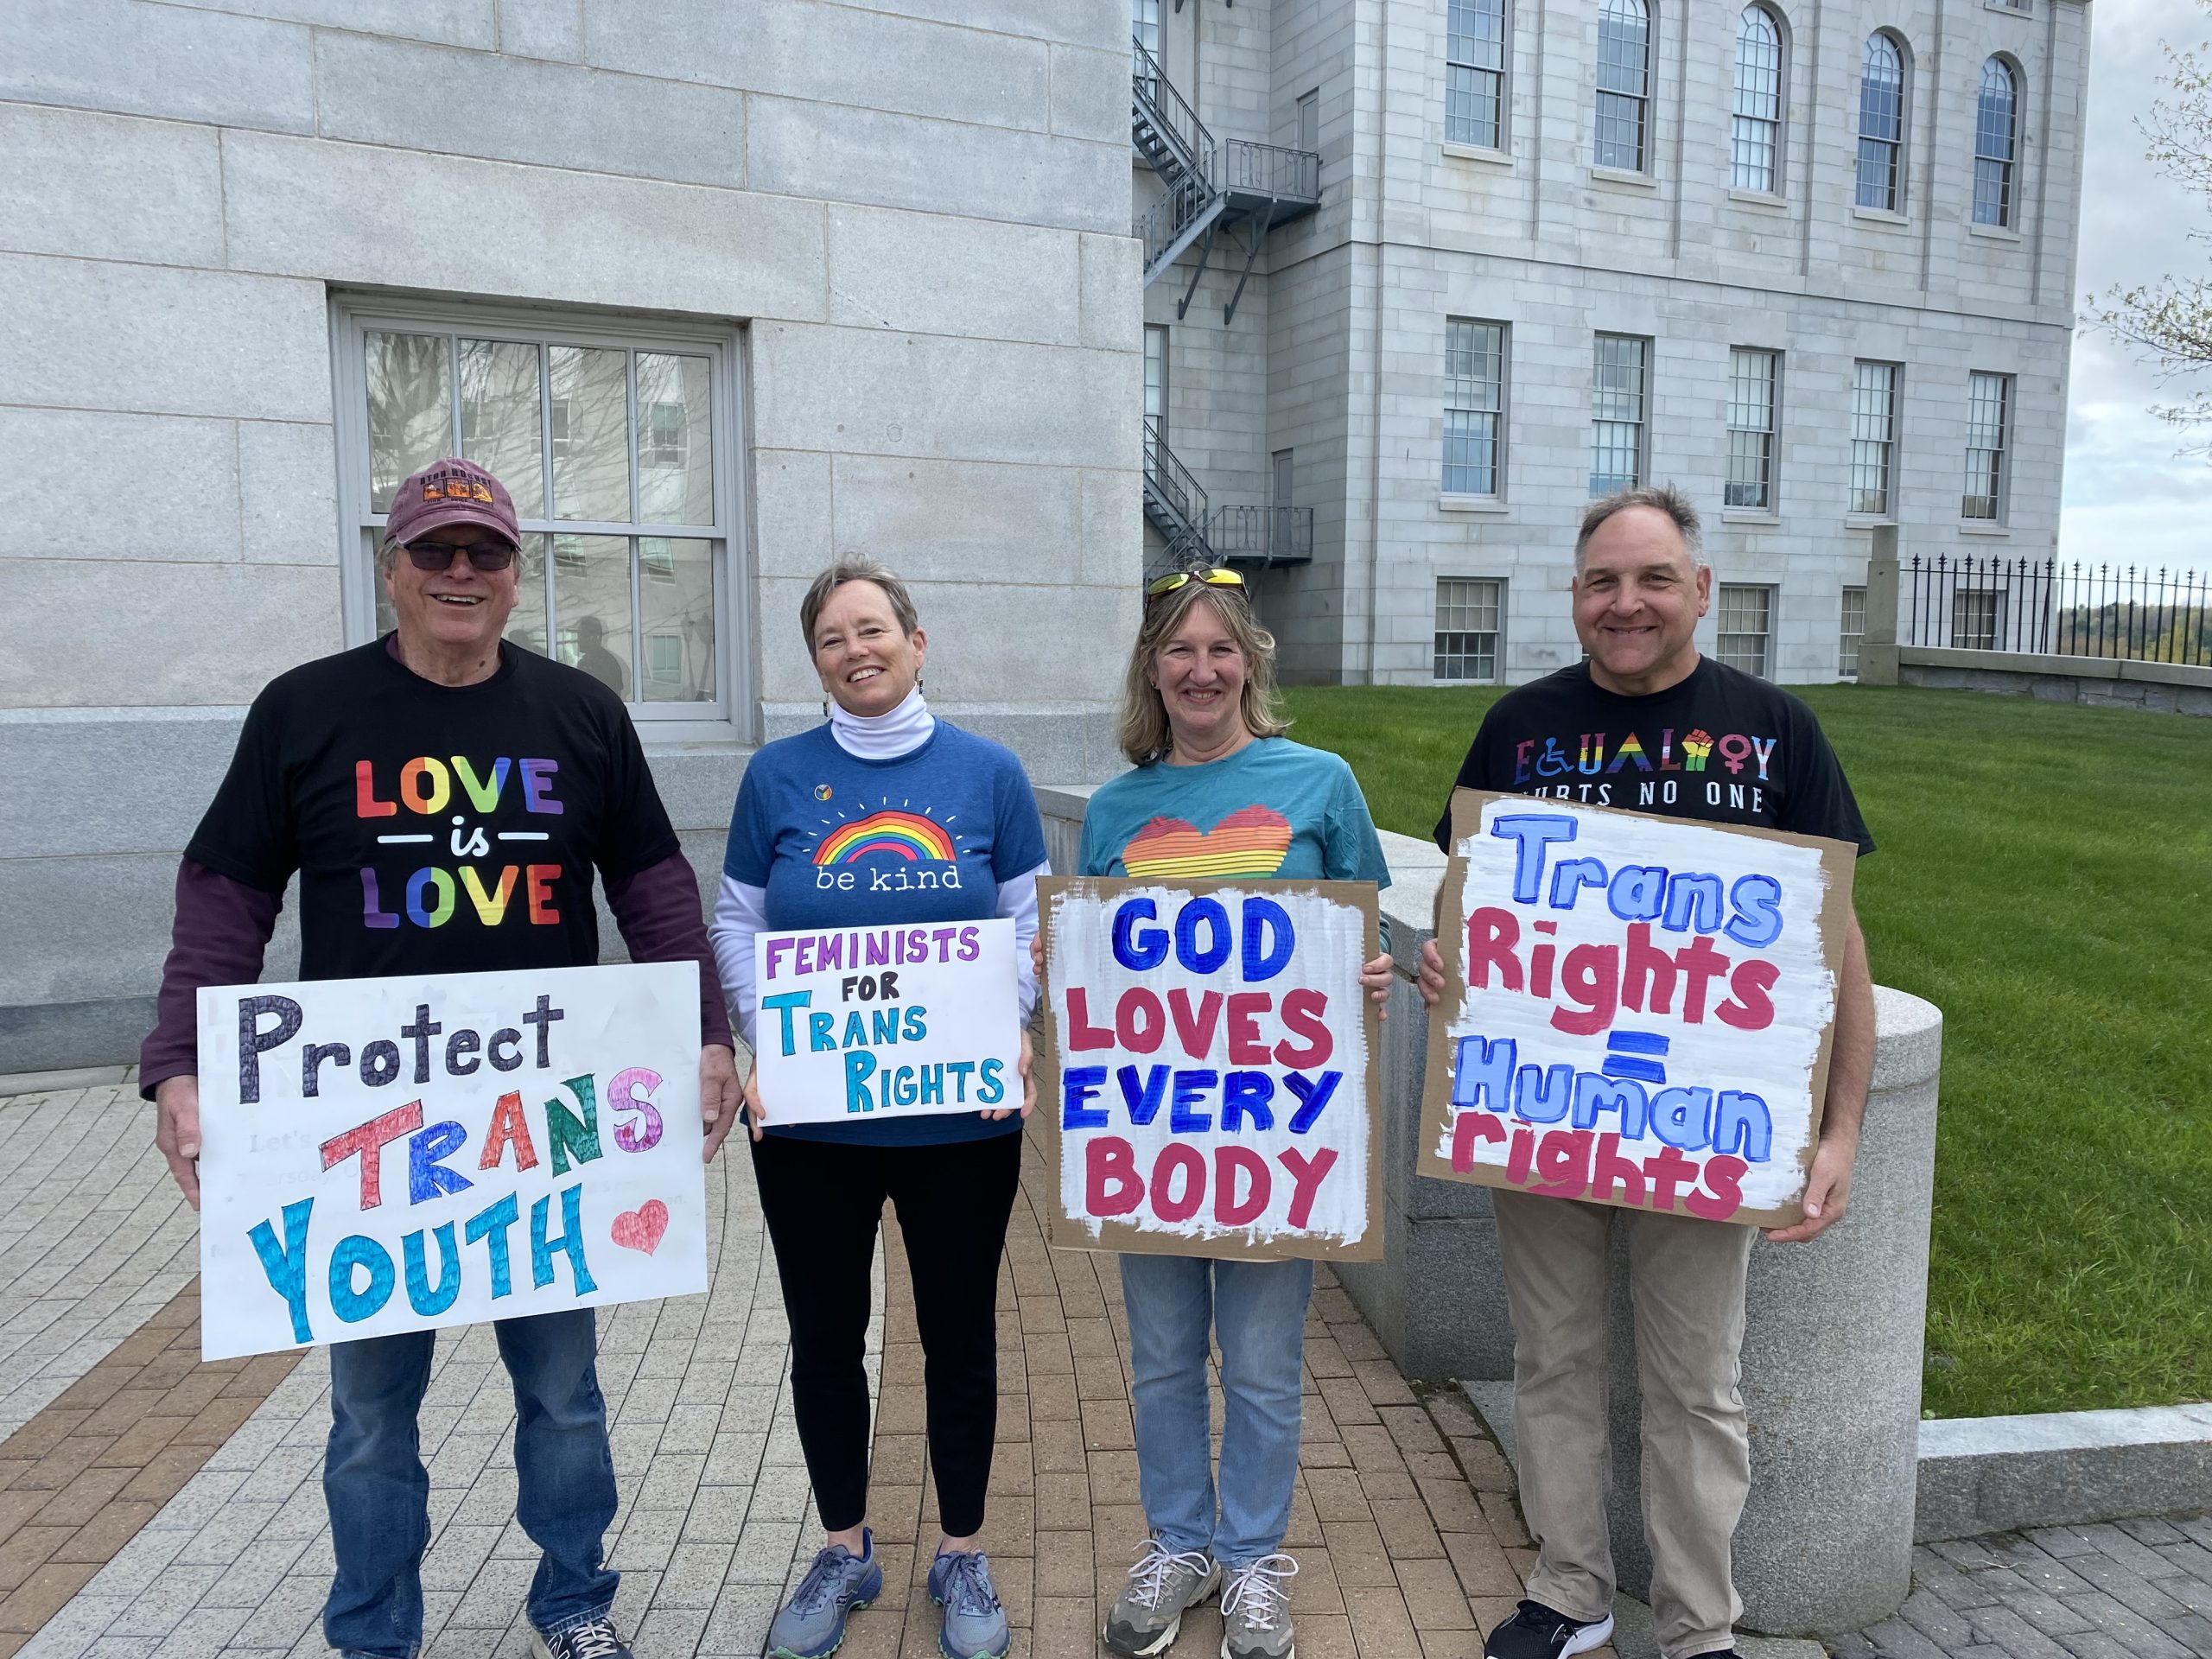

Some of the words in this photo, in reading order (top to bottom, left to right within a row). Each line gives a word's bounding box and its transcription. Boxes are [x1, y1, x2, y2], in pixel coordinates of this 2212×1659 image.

[355, 755, 563, 818] LOVE
[1514, 728, 1777, 785] EUALY
[1522, 783, 1612, 806] RTS
[1639, 781, 1677, 805] NO
[1707, 781, 1762, 813] ONE
[450, 816, 489, 856] is
[360, 864, 562, 929] LOVE
[817, 867, 854, 891] be
[870, 866, 963, 891] kind
[1491, 814, 1783, 948] Trans
[766, 926, 980, 980] FEMINISTS
[1111, 896, 1295, 982] GOD
[1467, 906, 1781, 1035] Rights
[842, 971, 899, 1001] FOR
[238, 994, 564, 1104] Protect
[761, 990, 927, 1056] TRANS
[1065, 987, 1333, 1070] LOVES
[844, 1050, 1003, 1113] RIGHTS
[1062, 1064, 1344, 1135] EVERY
[1452, 1035, 1772, 1162] Human
[319, 1066, 664, 1211] TRANS
[1451, 1110, 1751, 1221] rights
[1085, 1135, 1338, 1230] BODY
[245, 1182, 598, 1344] YOUTH
